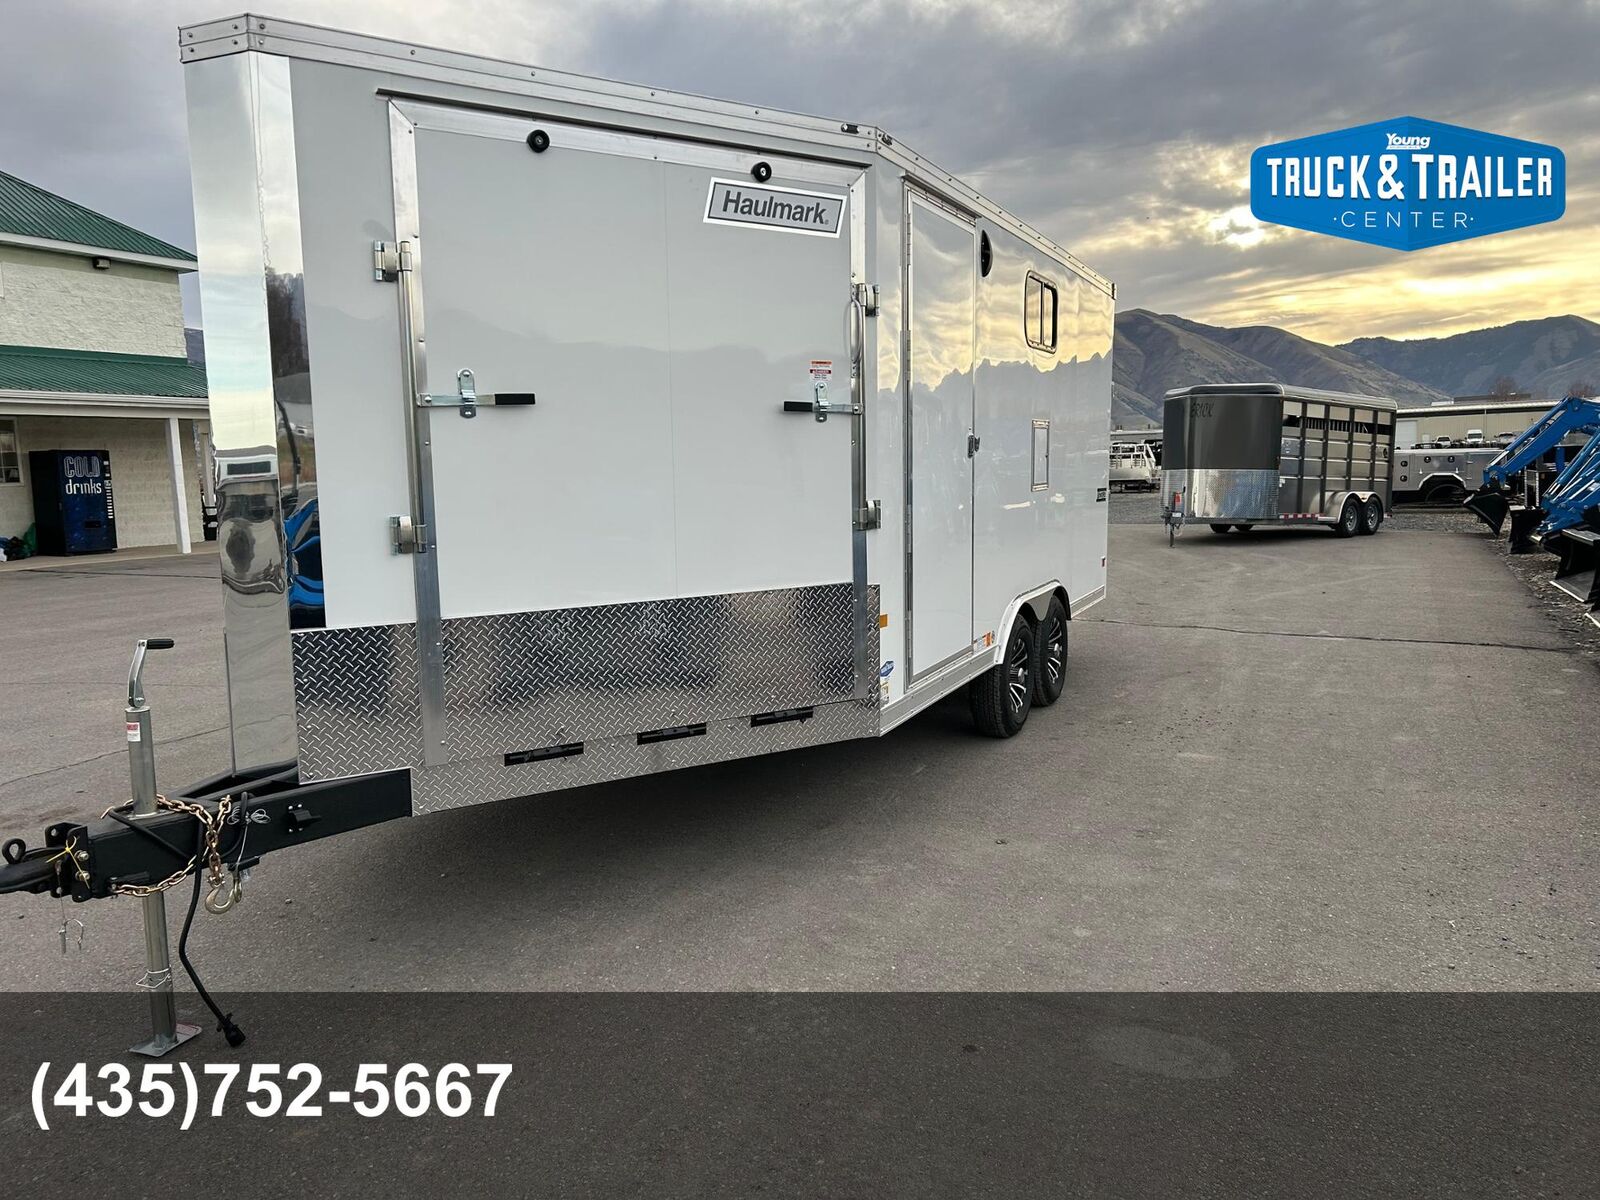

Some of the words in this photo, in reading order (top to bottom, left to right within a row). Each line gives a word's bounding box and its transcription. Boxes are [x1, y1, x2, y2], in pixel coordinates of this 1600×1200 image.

[722, 190, 827, 225] Haulmark
[63, 456, 101, 478] COLD
[65, 479, 102, 495] drinks
